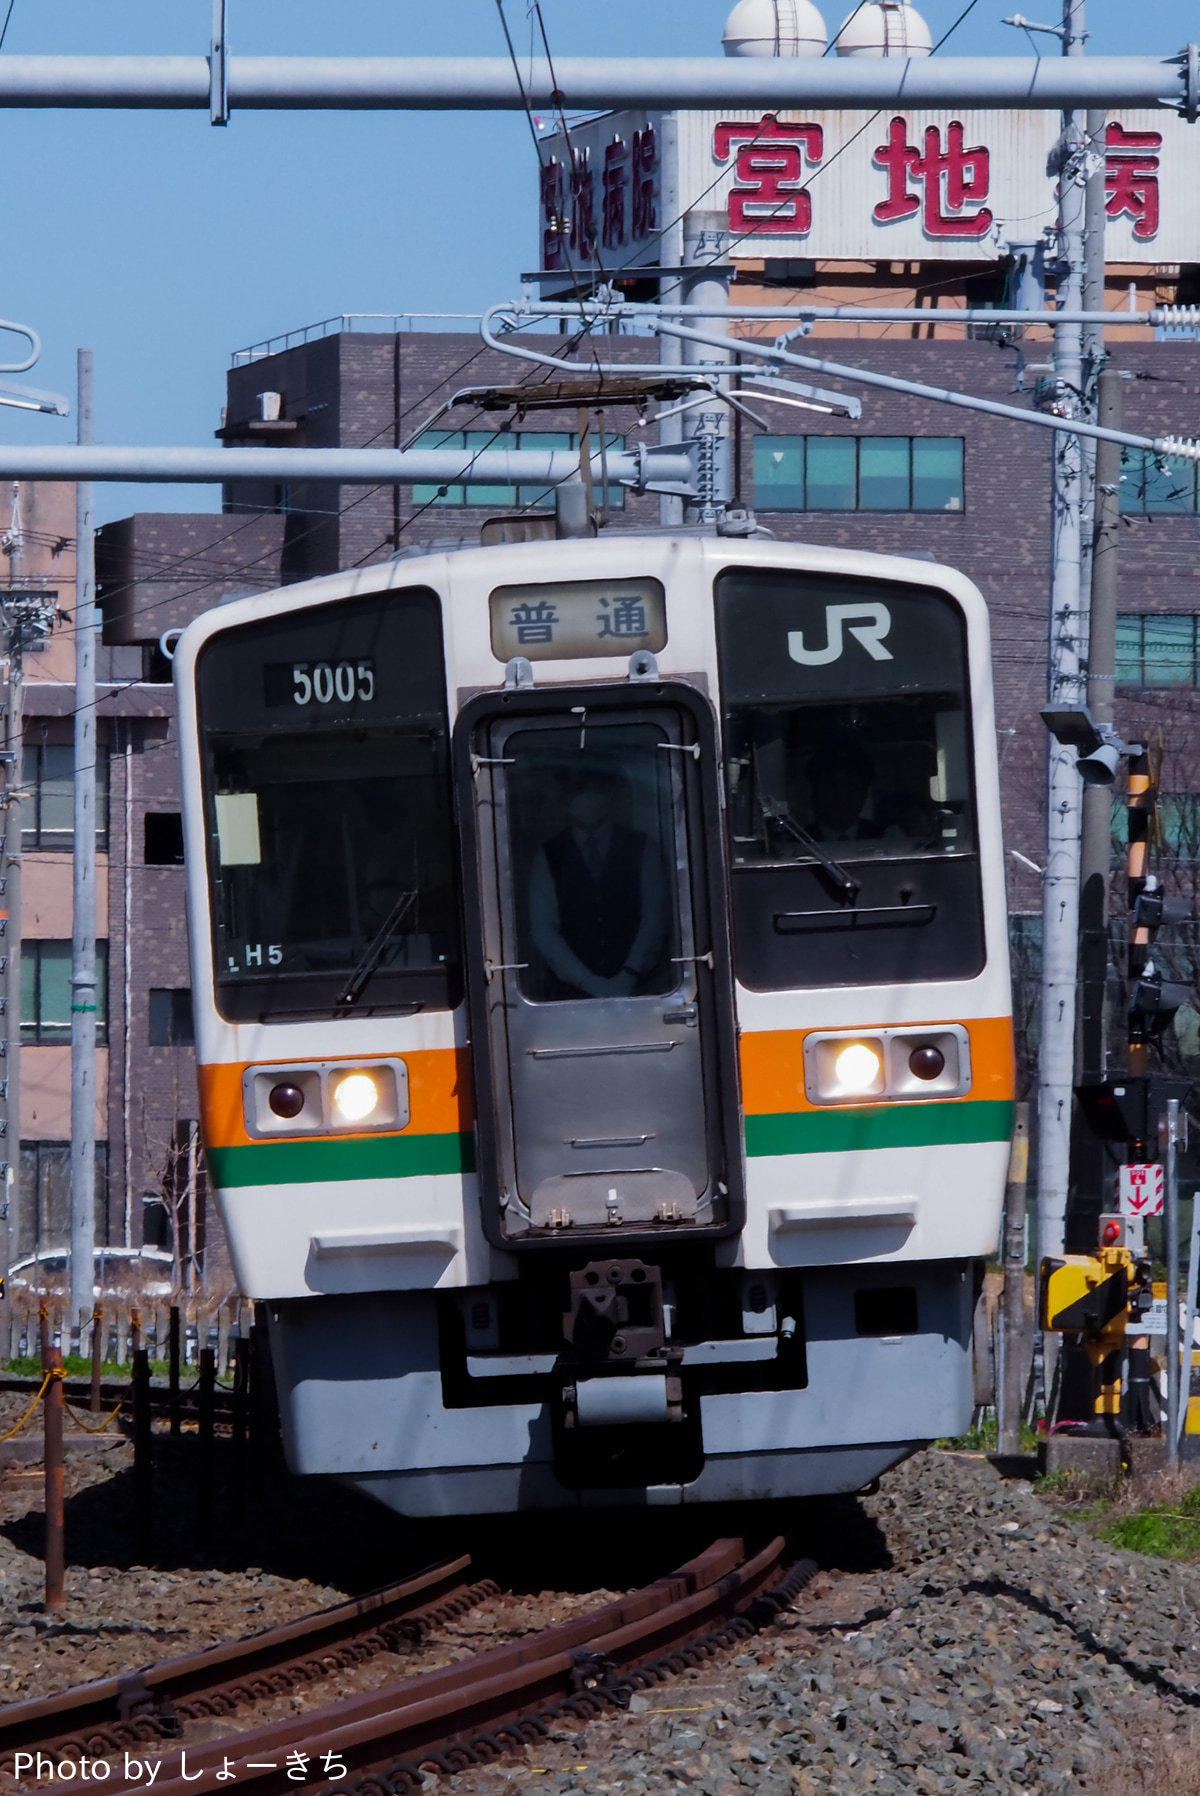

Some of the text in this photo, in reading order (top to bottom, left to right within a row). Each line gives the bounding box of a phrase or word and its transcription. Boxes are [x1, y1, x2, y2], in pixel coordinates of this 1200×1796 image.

[508, 595, 650, 645] 普通
[787, 602, 894, 666] JR
[293, 660, 374, 705] 5005
